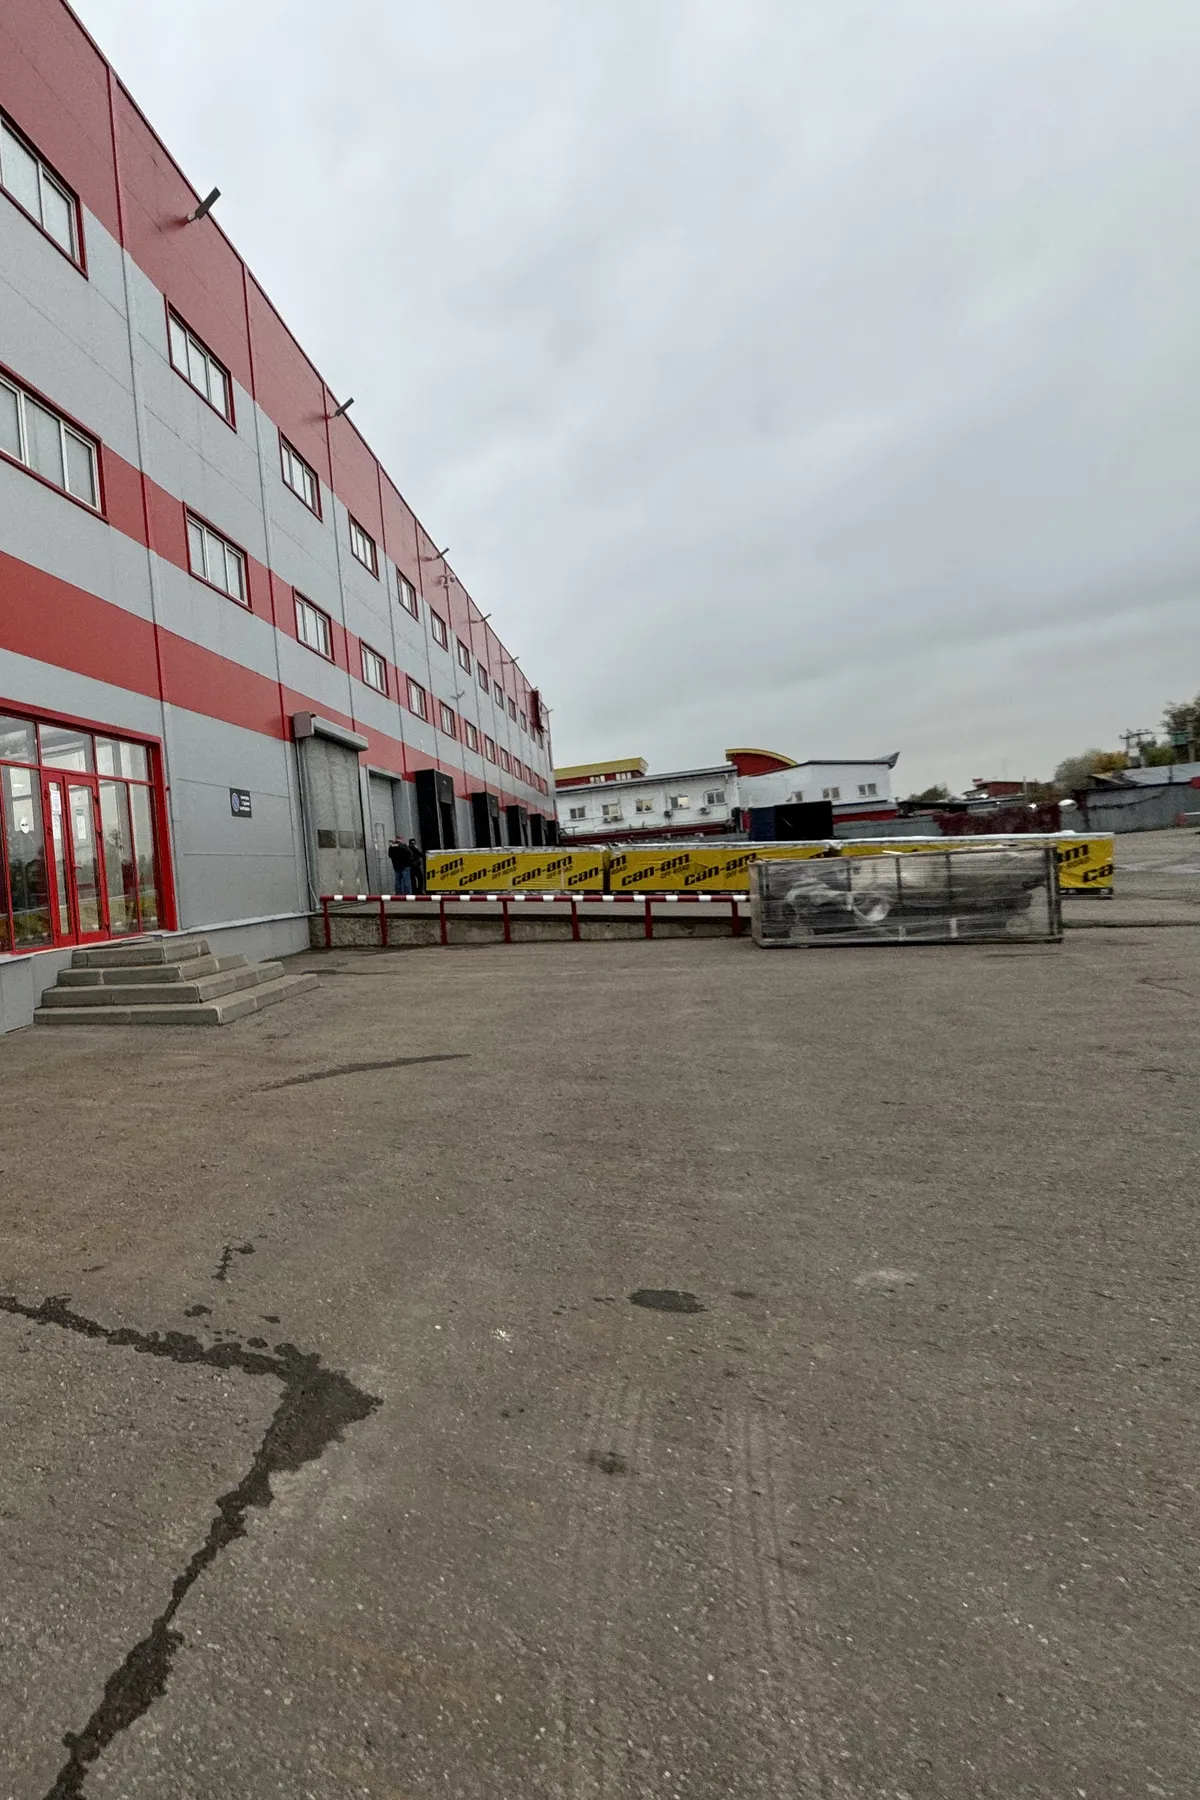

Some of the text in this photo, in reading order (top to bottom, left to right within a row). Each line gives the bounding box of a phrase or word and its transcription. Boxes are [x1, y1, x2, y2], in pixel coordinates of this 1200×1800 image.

[459, 856, 516, 886] can-am
[512, 855, 572, 886] can-am
[621, 853, 689, 886] can-am
[684, 852, 757, 886] can-am
